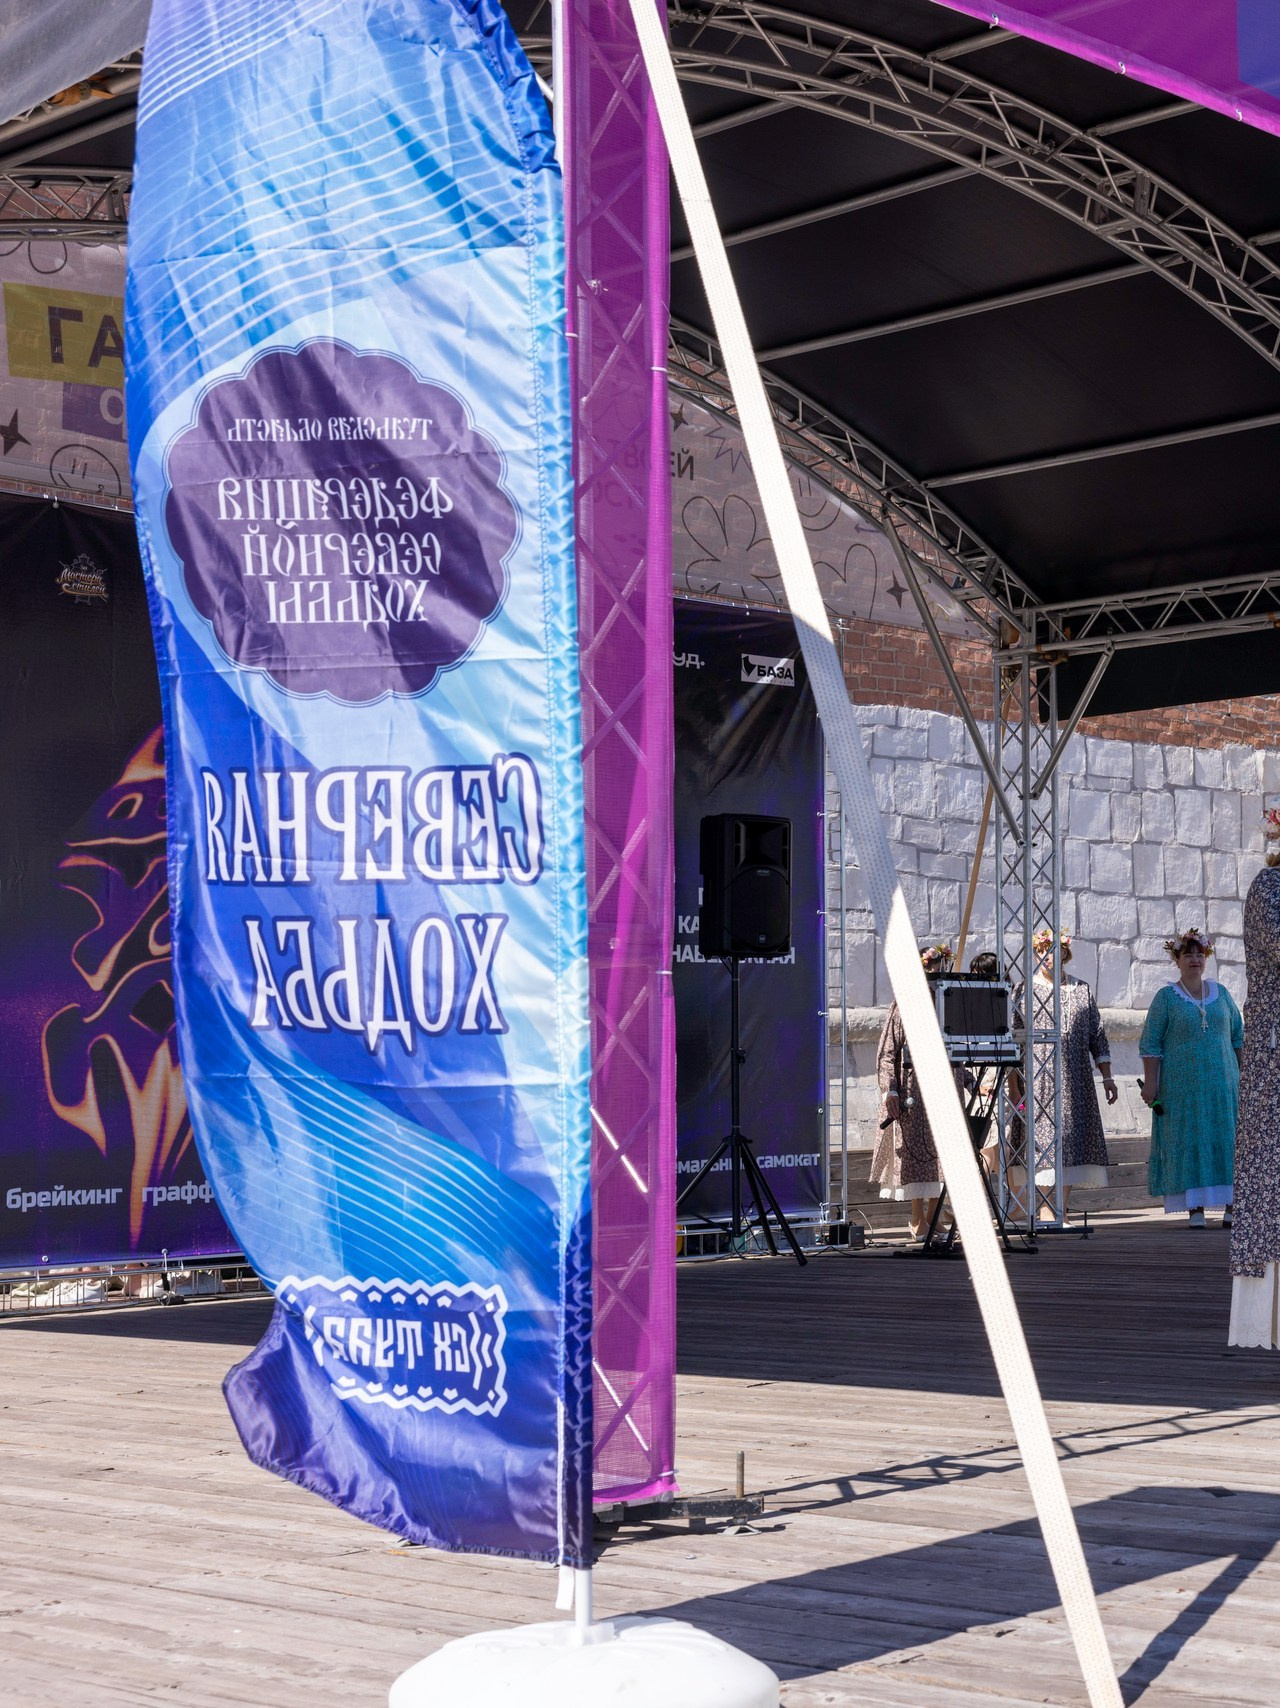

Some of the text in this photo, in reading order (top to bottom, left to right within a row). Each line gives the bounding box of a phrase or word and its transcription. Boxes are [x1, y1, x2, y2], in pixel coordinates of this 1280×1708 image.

[757, 665, 793, 680] БАЗА
[756, 1153, 820, 1169] самокат
[6, 1185, 123, 1212] брейкинг
